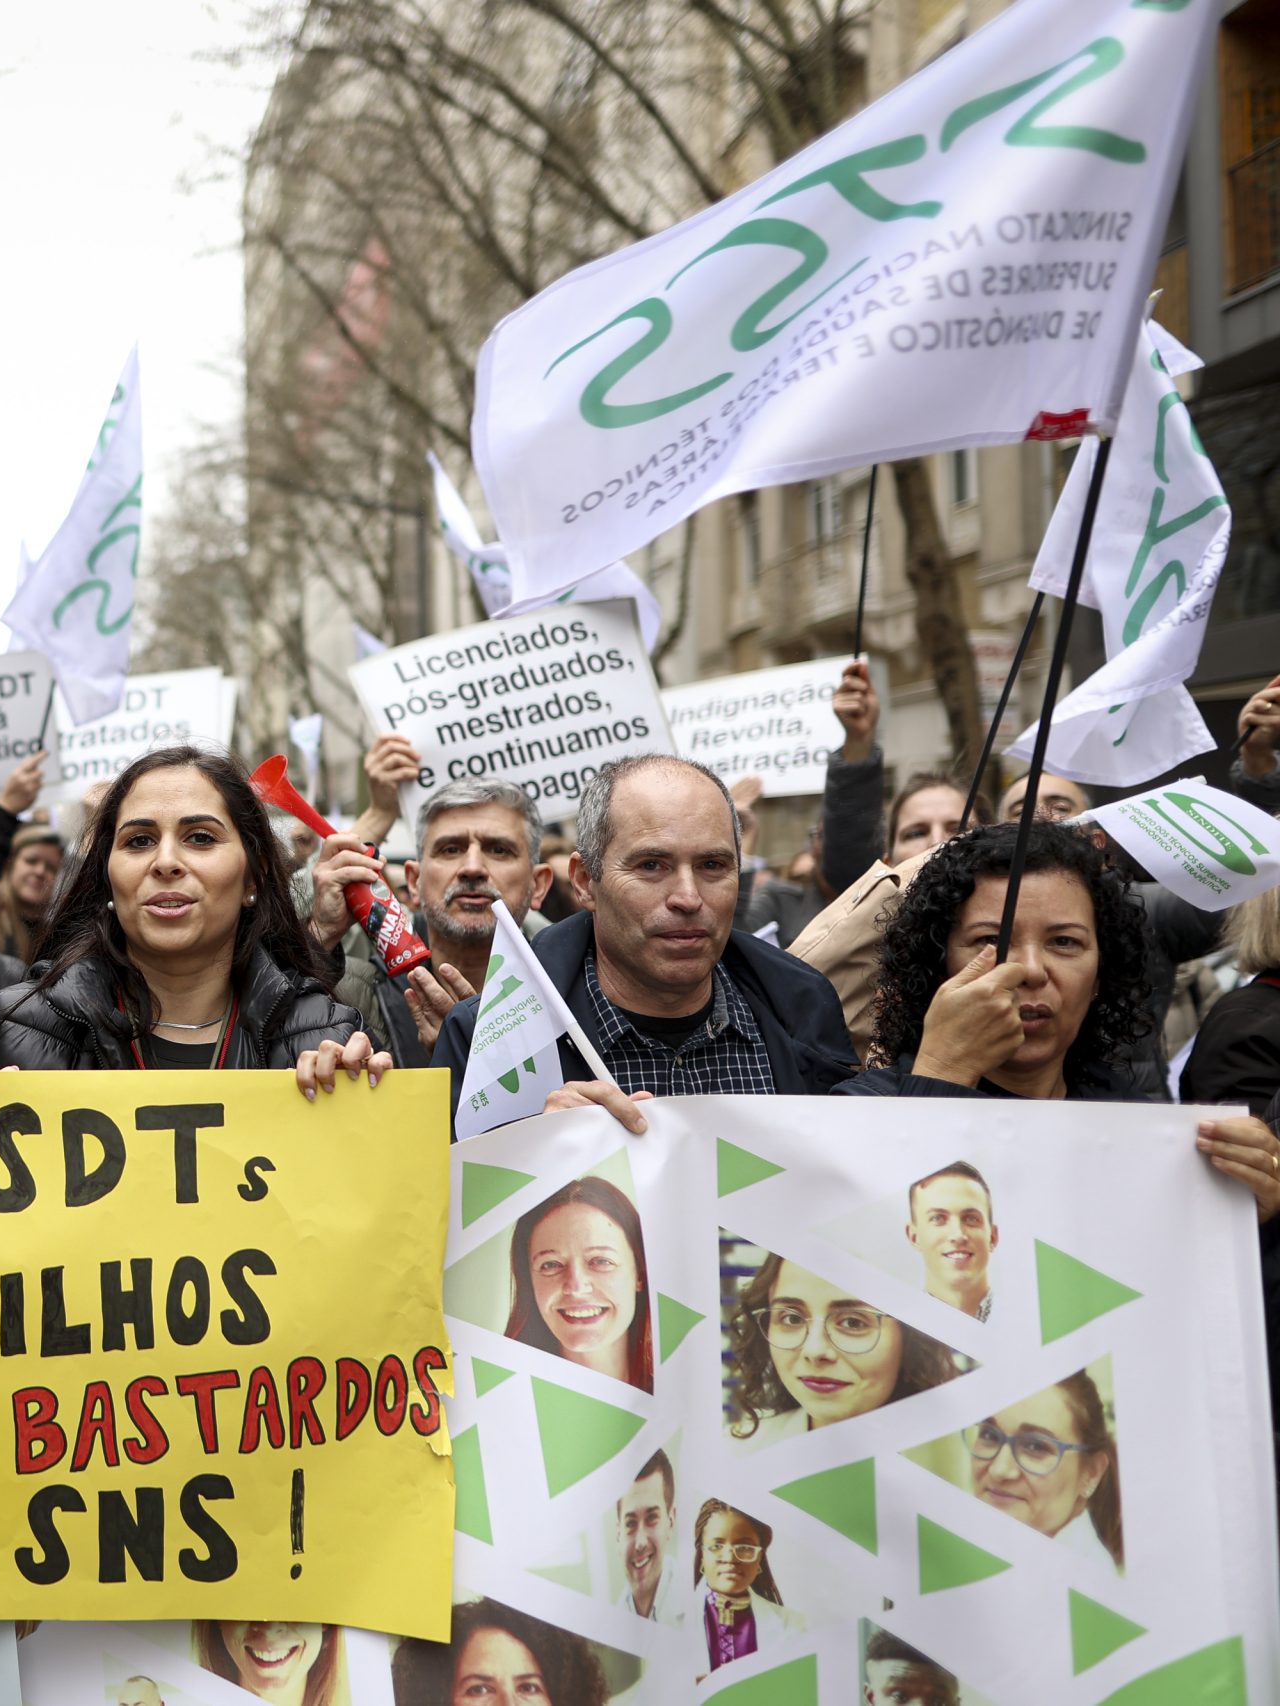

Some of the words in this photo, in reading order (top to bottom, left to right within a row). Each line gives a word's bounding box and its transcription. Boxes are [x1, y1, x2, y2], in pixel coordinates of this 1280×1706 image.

[383, 647, 634, 729] pós-graduados,
[393, 619, 598, 684] Licenciados,
[417, 765, 435, 789] e
[448, 716, 650, 782] continuamos
[436, 689, 612, 746] mestrados,
[521, 761, 615, 803] pago
[13, 1345, 448, 1476] BASTARDOS
[15, 1474, 239, 1586] SNS
